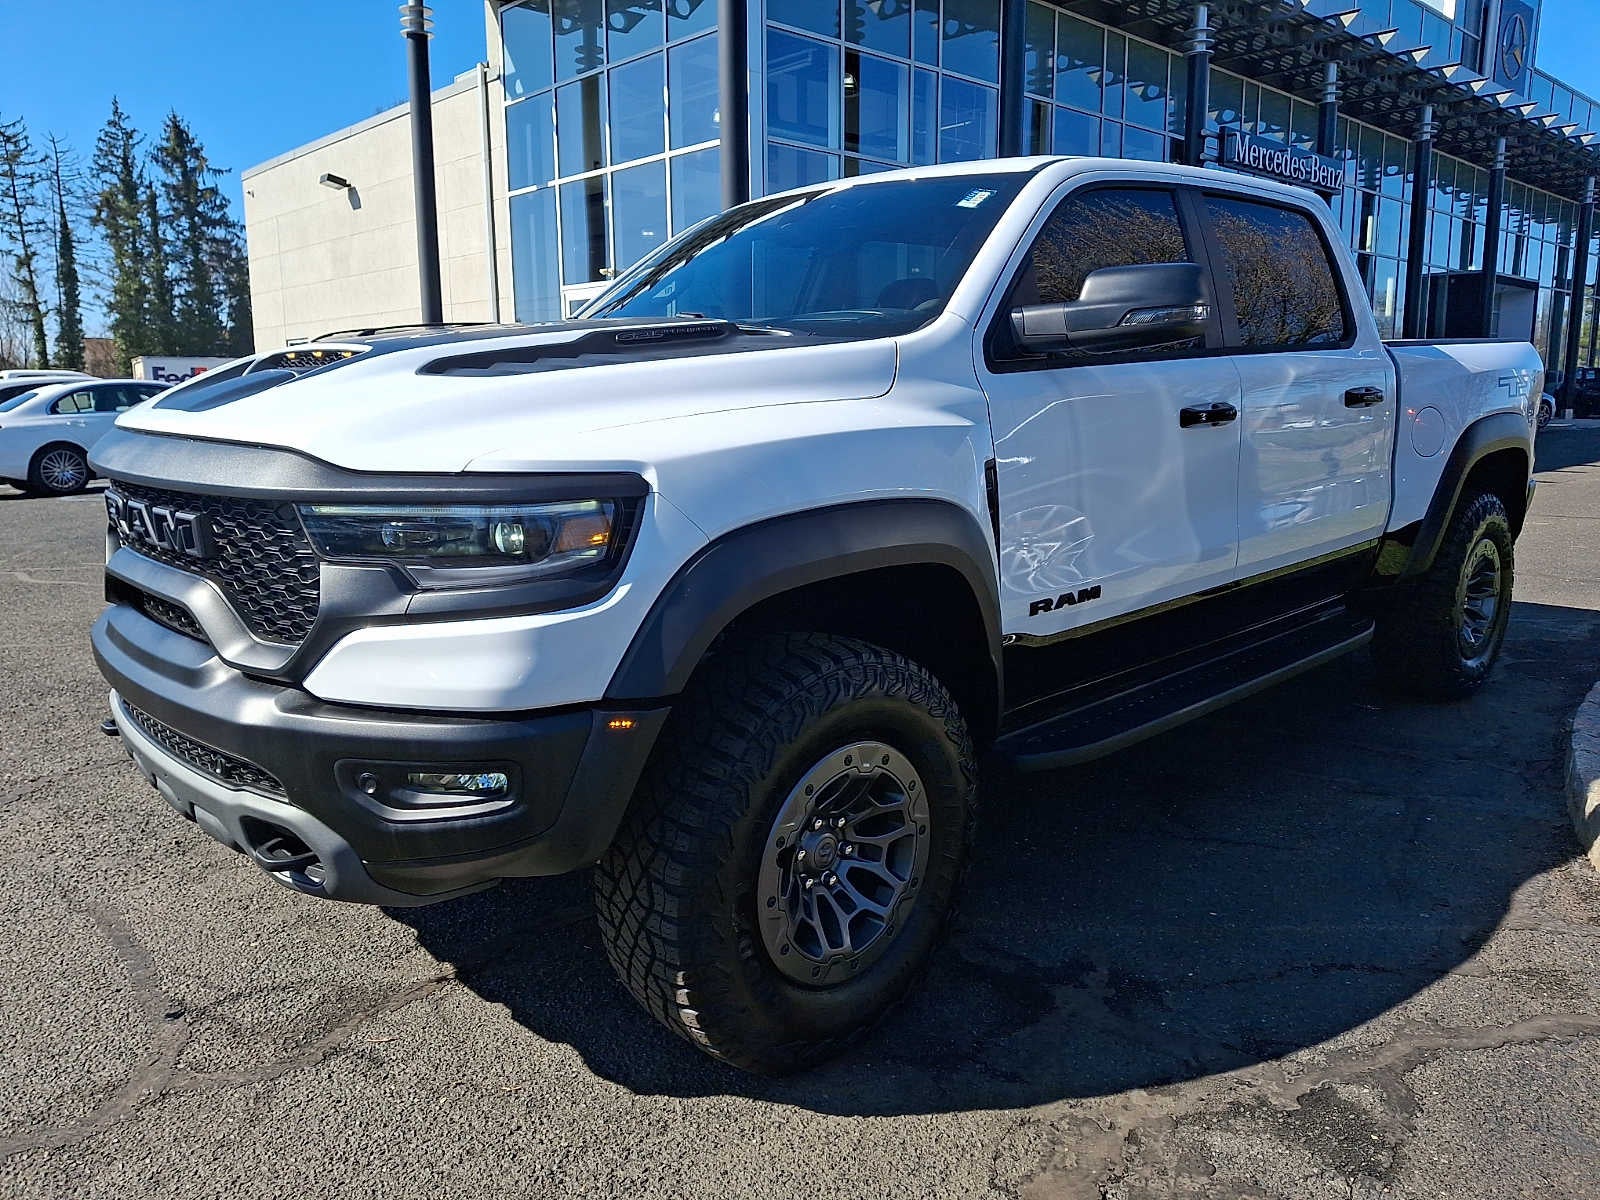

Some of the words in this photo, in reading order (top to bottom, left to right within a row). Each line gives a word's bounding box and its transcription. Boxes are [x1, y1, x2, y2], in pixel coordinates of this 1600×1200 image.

[1234, 131, 1343, 190] Mercedes-Benz
[152, 366, 208, 385] FedE
[104, 488, 202, 558] RAM
[1029, 585, 1102, 617] RAM
